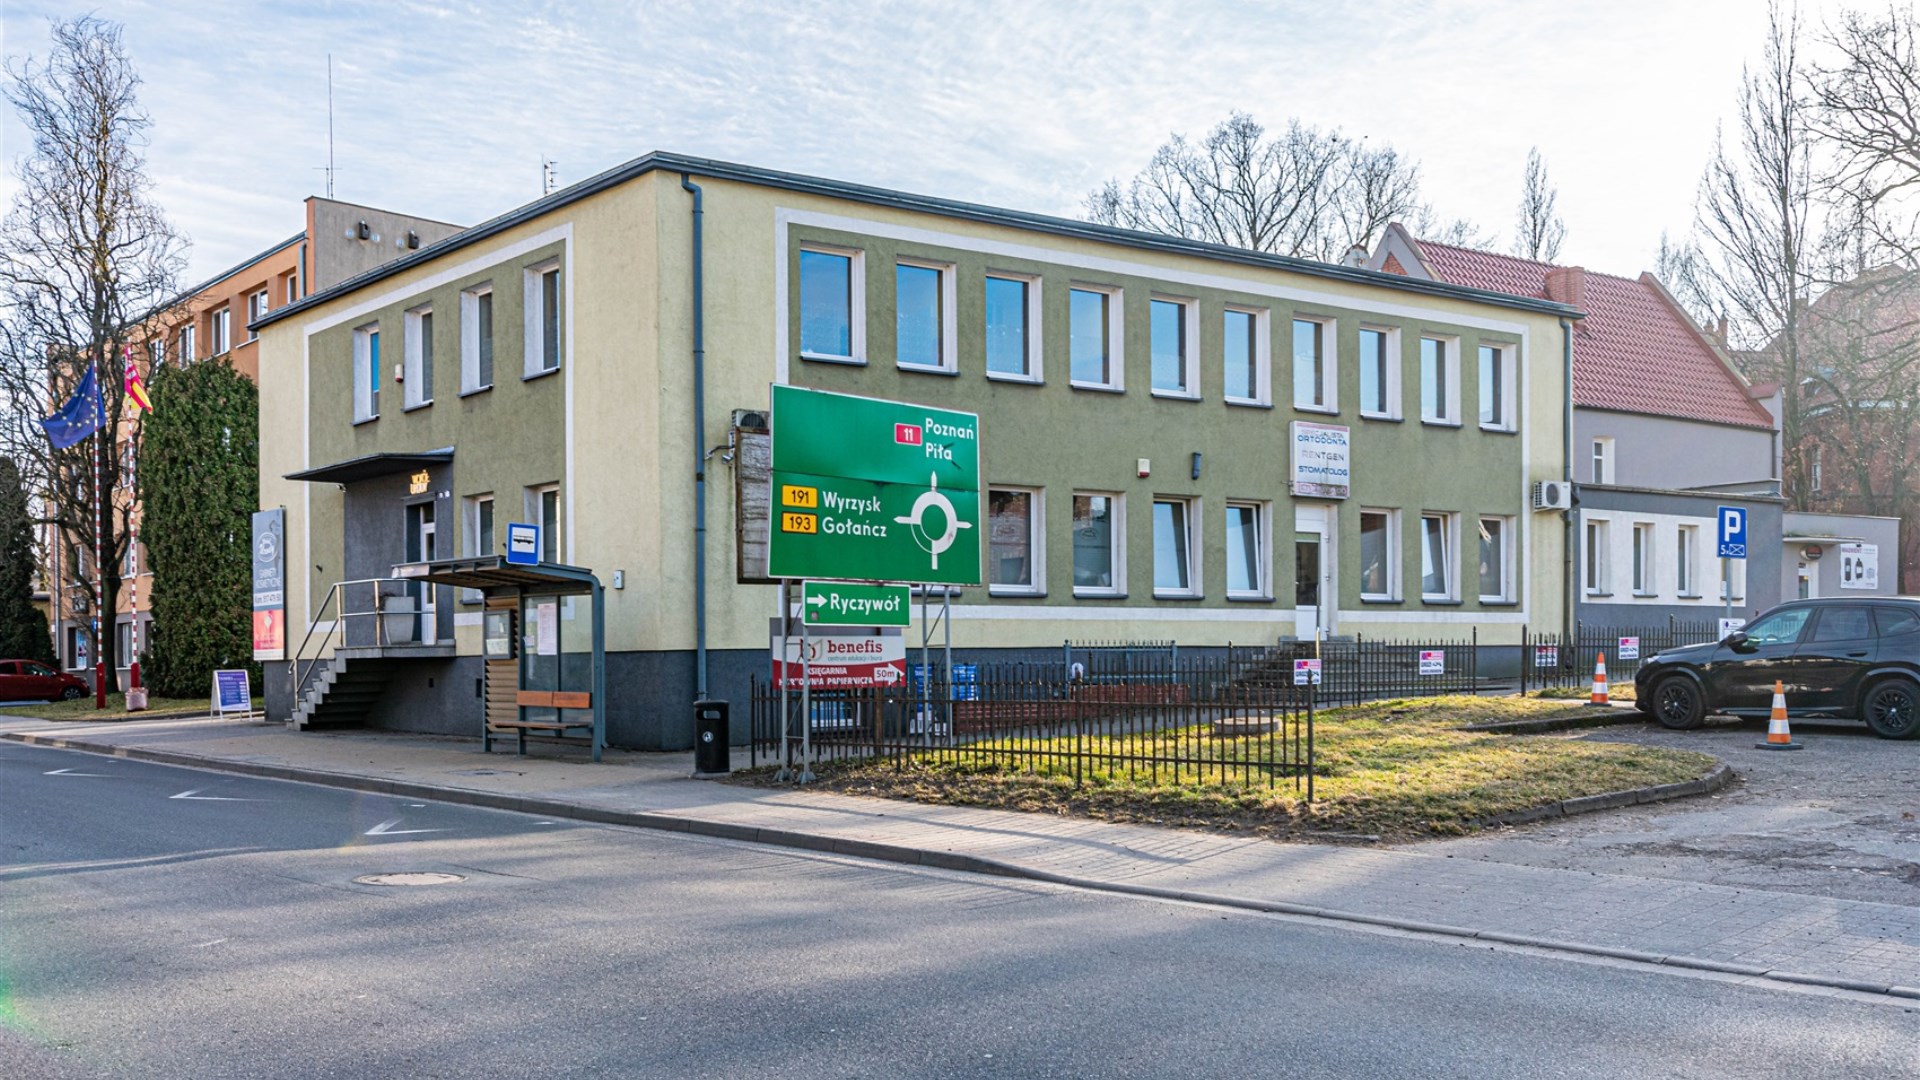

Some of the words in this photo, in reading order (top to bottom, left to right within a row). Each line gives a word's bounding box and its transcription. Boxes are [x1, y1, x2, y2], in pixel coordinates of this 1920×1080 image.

[903, 428, 914, 442] 11
[925, 417, 974, 441] Poznań
[1297, 435, 1347, 446] ORTODONTA
[925, 442, 952, 461] Piła
[1301, 450, 1345, 461] RENTGEN
[1298, 465, 1348, 477] STOMATOLOG
[791, 489, 810, 505] 191
[822, 491, 881, 515] Wyrzysk
[789, 516, 812, 531] 193
[822, 517, 887, 538] Gołańcz
[1724, 510, 1741, 542] P
[830, 592, 900, 616] Ryczywół
[827, 640, 883, 654] benefis
[876, 669, 895, 679] 50m
